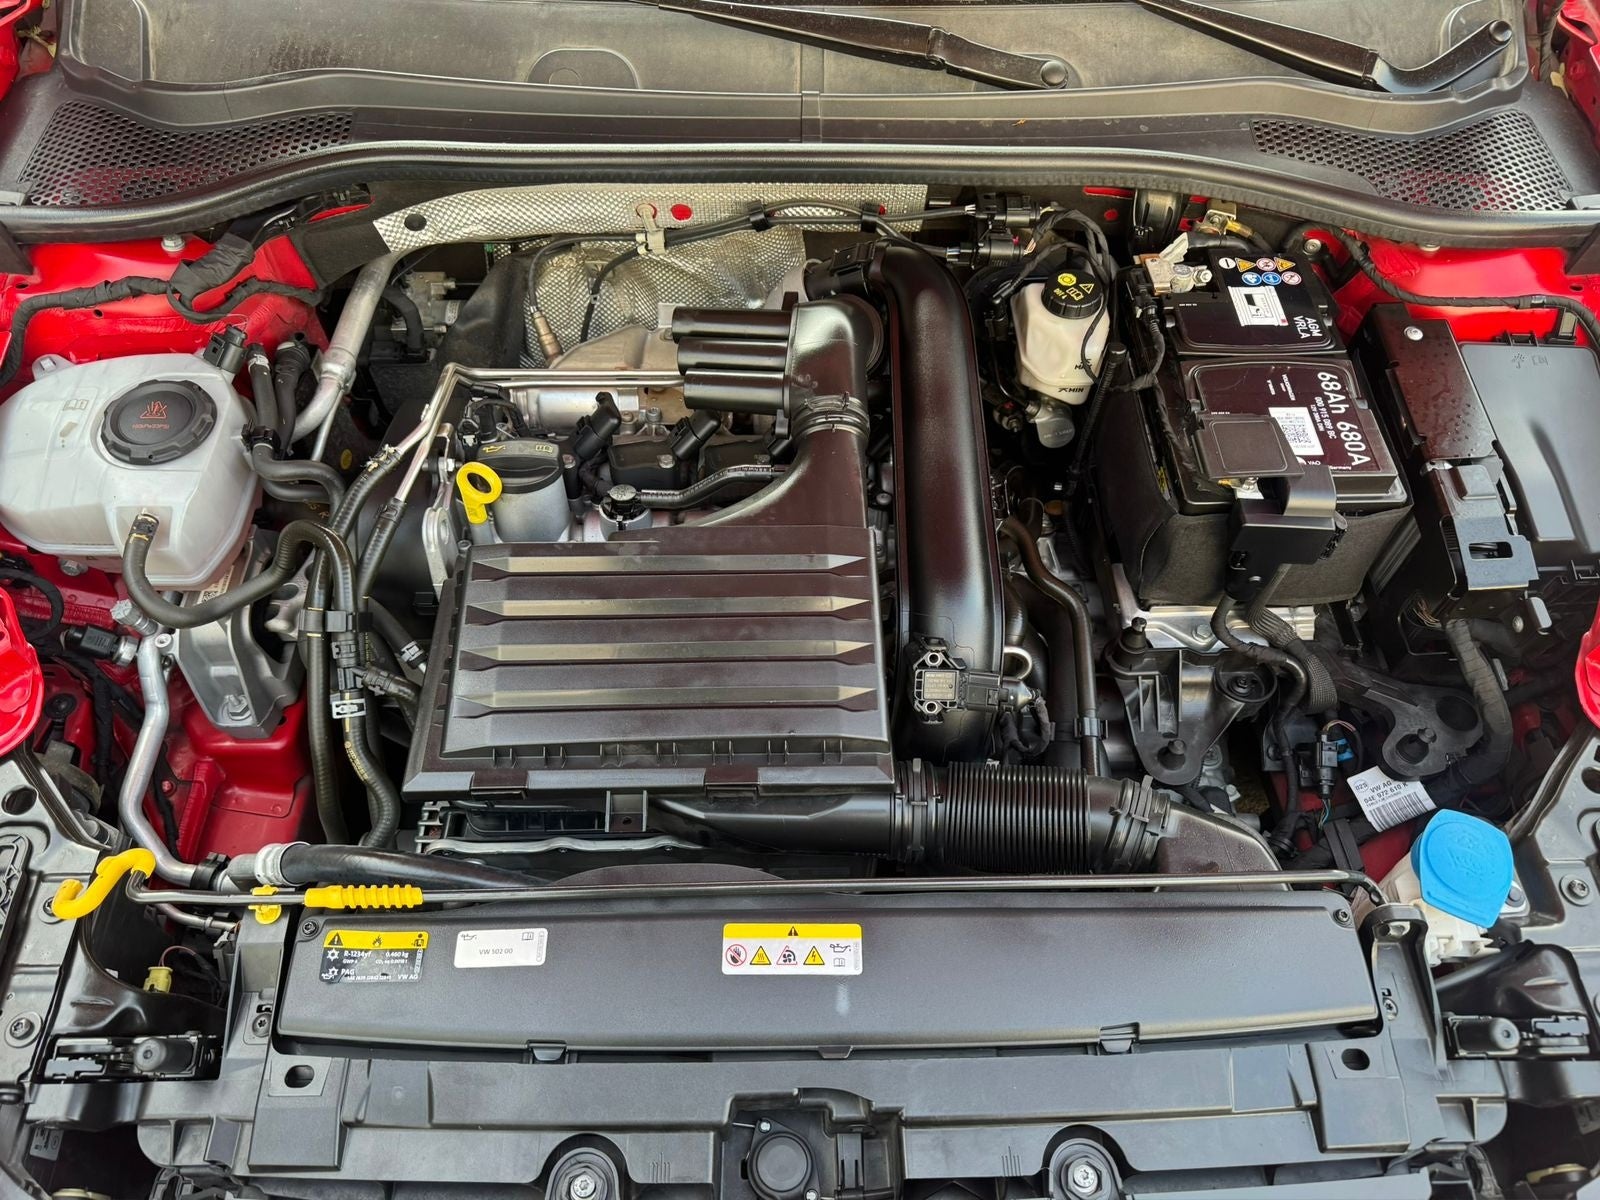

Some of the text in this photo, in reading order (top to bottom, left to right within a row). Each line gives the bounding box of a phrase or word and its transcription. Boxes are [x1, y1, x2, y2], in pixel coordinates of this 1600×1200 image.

[1293, 315, 1311, 339] VRLA
[1305, 317, 1323, 337] AGM
[1317, 372, 1371, 466] 68Ah 680A
[1319, 407, 1330, 418] 915
[1363, 795, 1375, 804] 04E
[1376, 789, 1389, 798] 972
[1389, 784, 1402, 793] 610
[1369, 780, 1393, 793] VW AG
[343, 950, 372, 959] R-1234yf
[401, 951, 409, 959] kg
